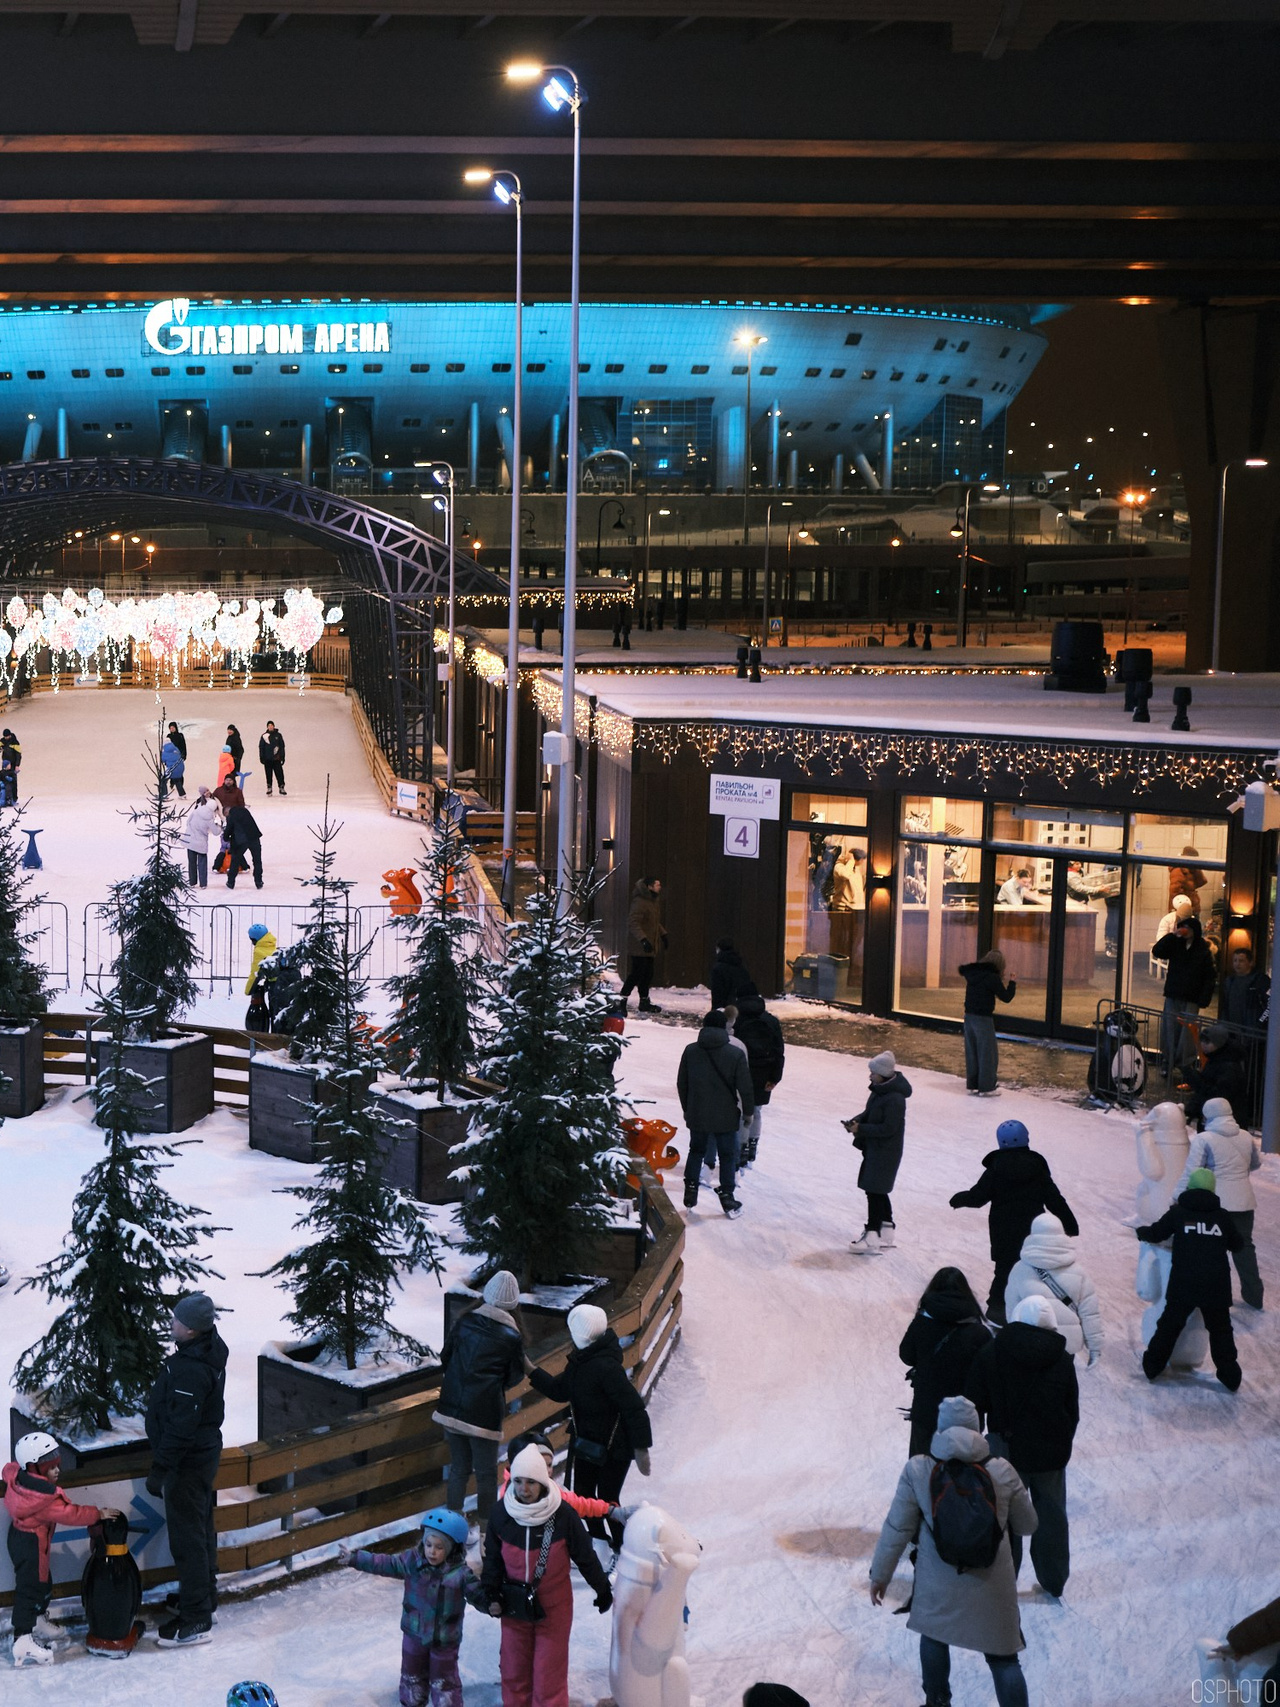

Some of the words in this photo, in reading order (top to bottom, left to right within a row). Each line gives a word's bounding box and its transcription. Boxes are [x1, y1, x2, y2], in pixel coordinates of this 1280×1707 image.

[192, 324, 303, 355] ГАЗПРОМ
[314, 322, 390, 353] АРЕНА
[715, 780, 754, 791] ПАВИЛЬОН
[715, 787, 746, 798] ПРОКАТА
[734, 825, 749, 847] 4
[1184, 1222, 1223, 1237] FILA
